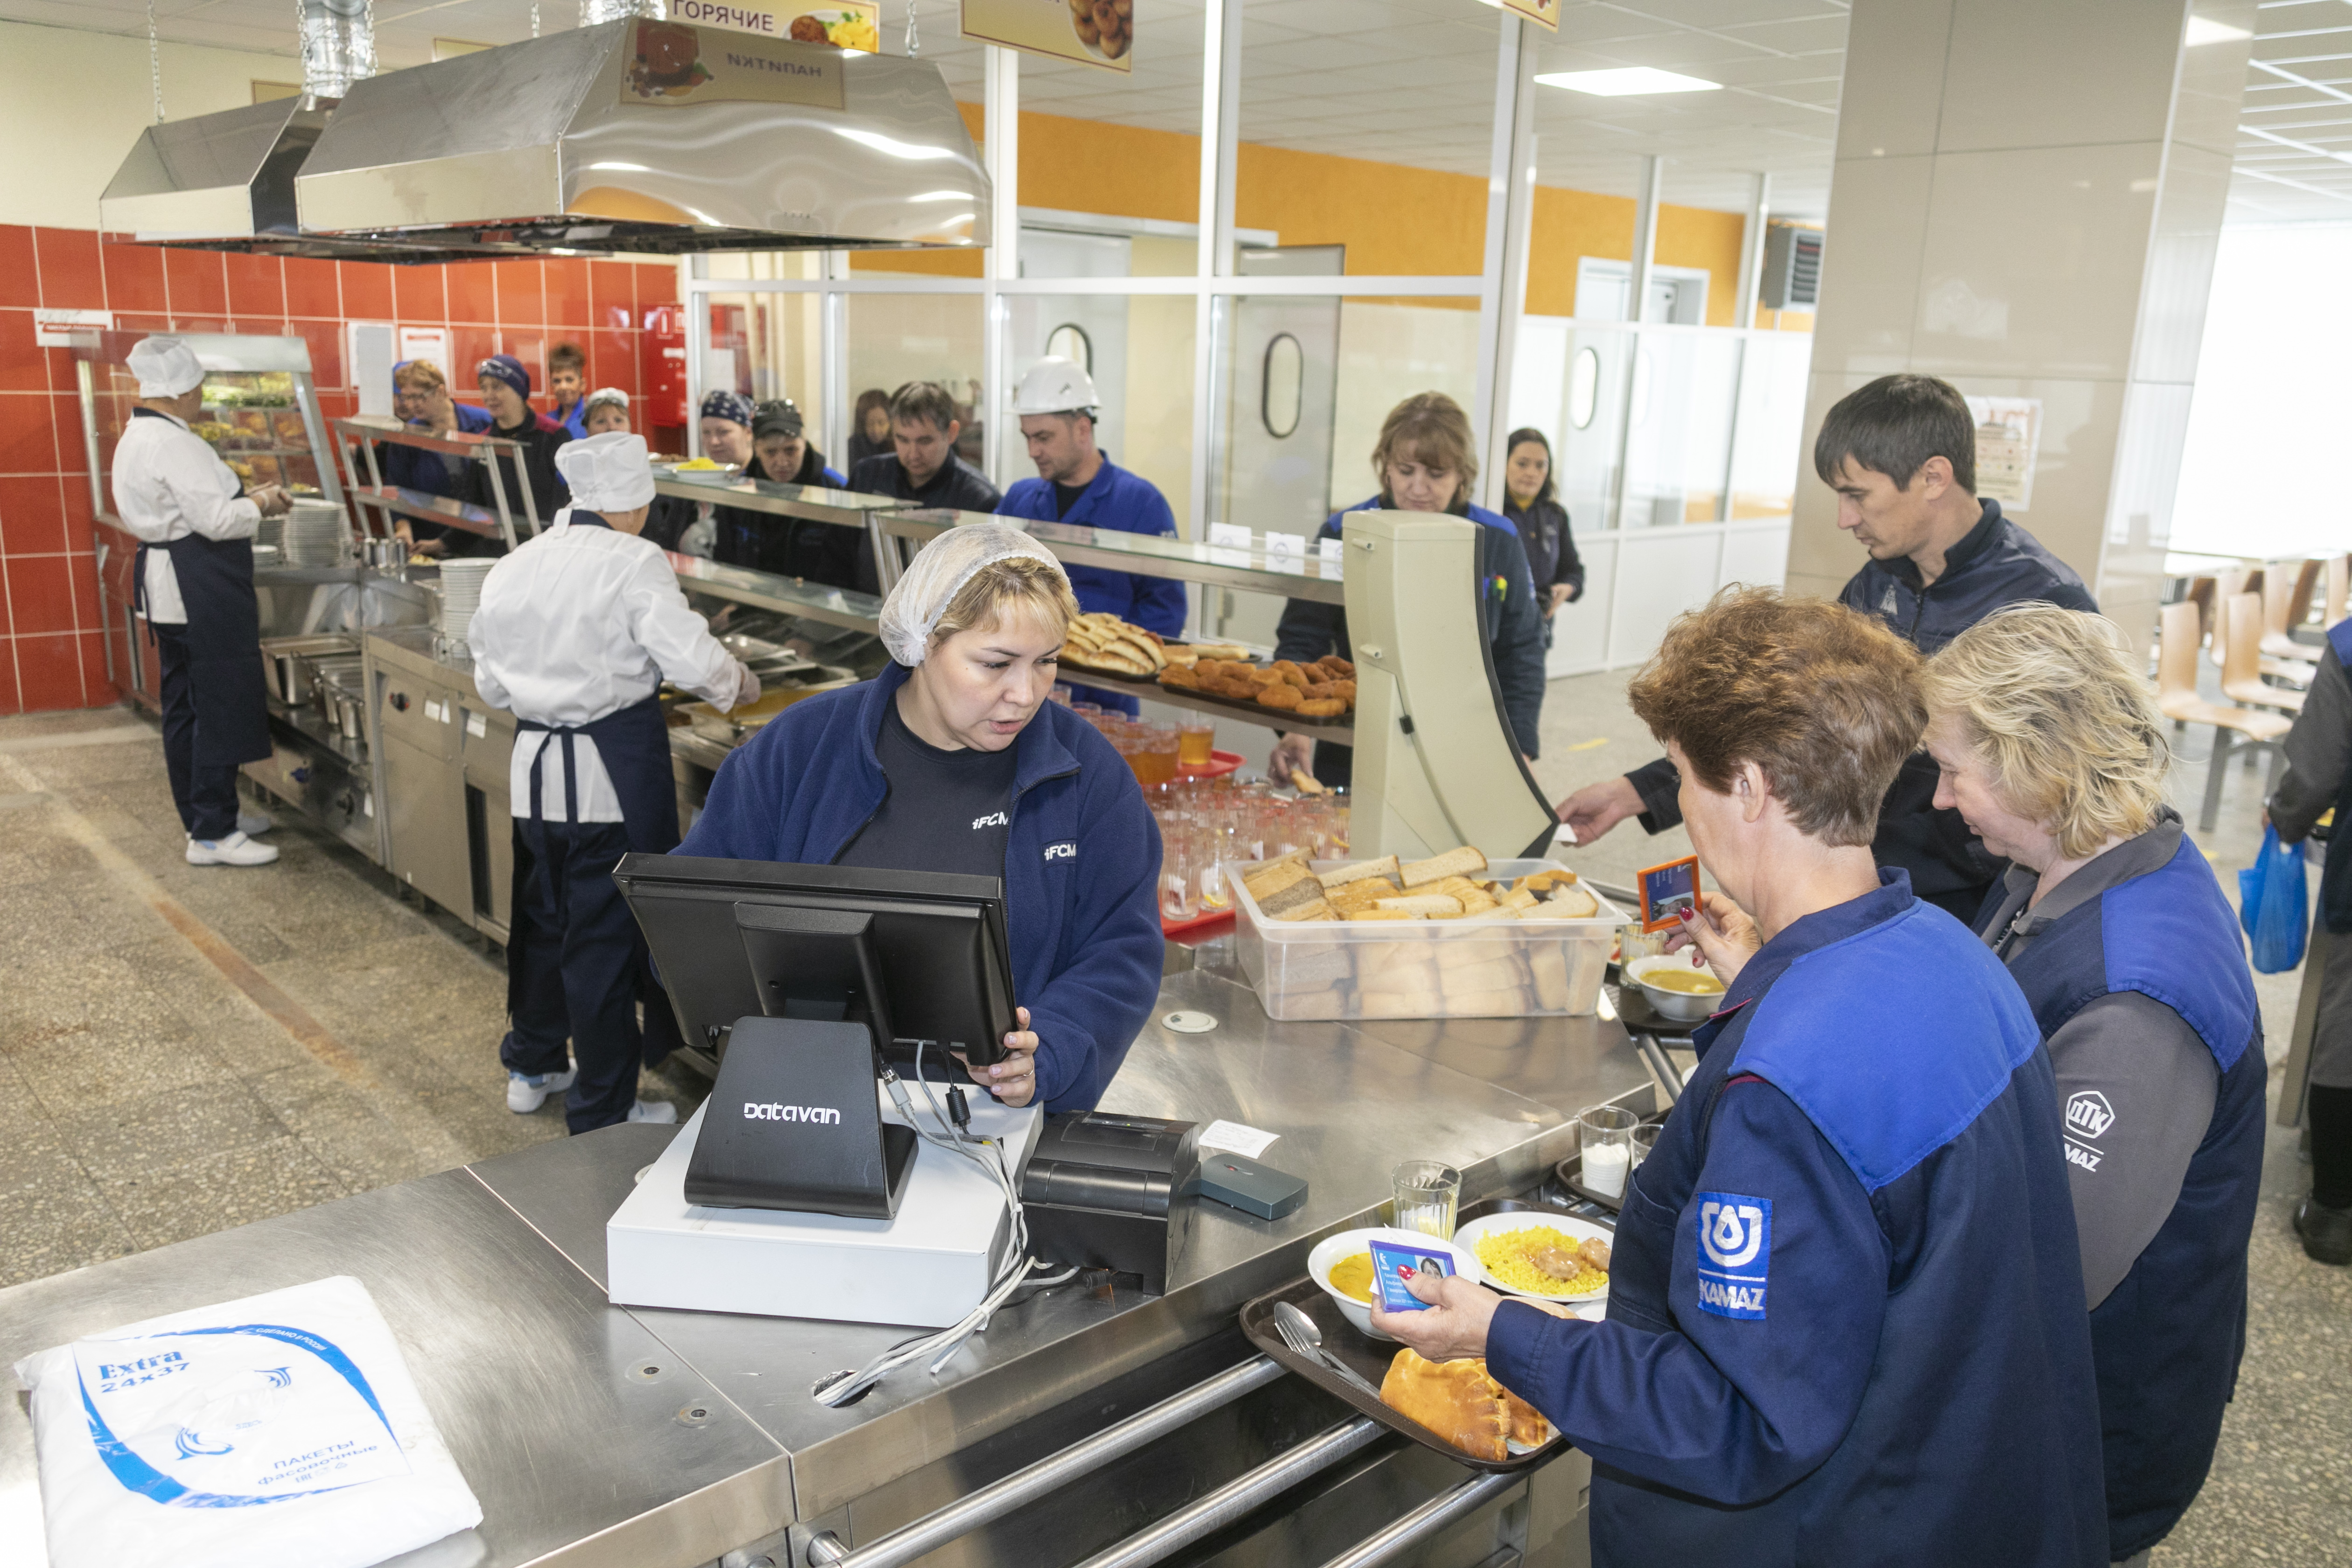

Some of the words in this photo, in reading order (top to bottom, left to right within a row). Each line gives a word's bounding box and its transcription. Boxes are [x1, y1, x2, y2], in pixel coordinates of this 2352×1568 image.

[672, 0, 774, 31] ГОРЯЧИЕ
[744, 1102, 840, 1125] Datavan
[2068, 1099, 2109, 1132] ДТК
[2064, 1143, 2101, 1172] MAZ
[1699, 1279, 1765, 1310] KAMAZ
[256, 1328, 297, 1338] СДЕЛАНО
[301, 1337, 328, 1351] РОССИИ
[98, 1351, 183, 1380] Extra
[101, 1362, 190, 1393] 24x37
[258, 1446, 377, 1484] фасовочные
[274, 1440, 354, 1469] ПАКЕТЫ
